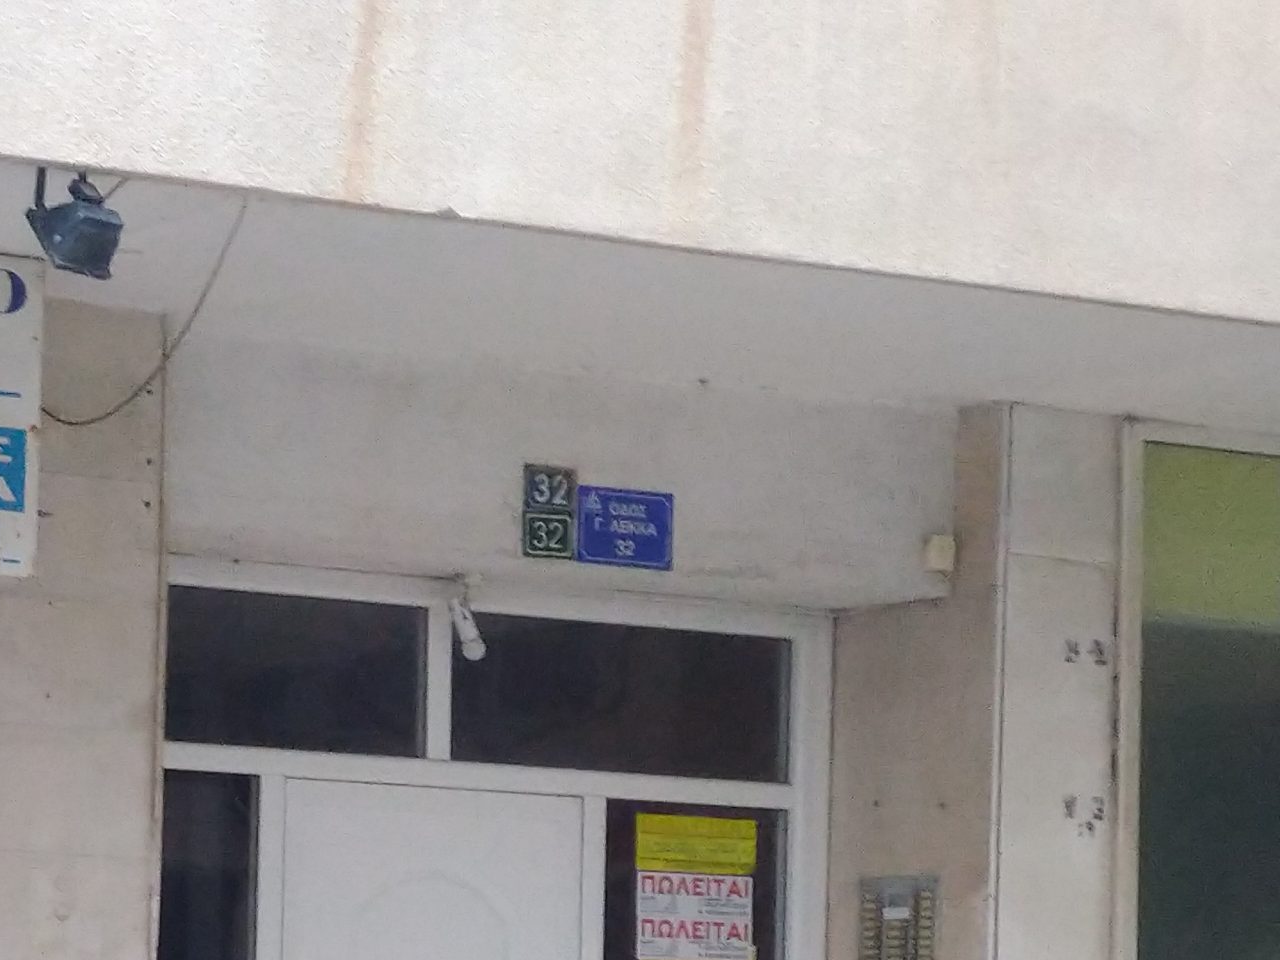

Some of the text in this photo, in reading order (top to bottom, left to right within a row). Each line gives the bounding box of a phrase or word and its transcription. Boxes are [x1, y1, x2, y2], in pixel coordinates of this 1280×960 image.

[533, 473, 568, 505] 32
[532, 520, 565, 549] 32
[641, 875, 749, 898] ΠΩΛΕΙΤΑΙ
[641, 918, 749, 942] ΠΩΛΕΙΤΑΙ
